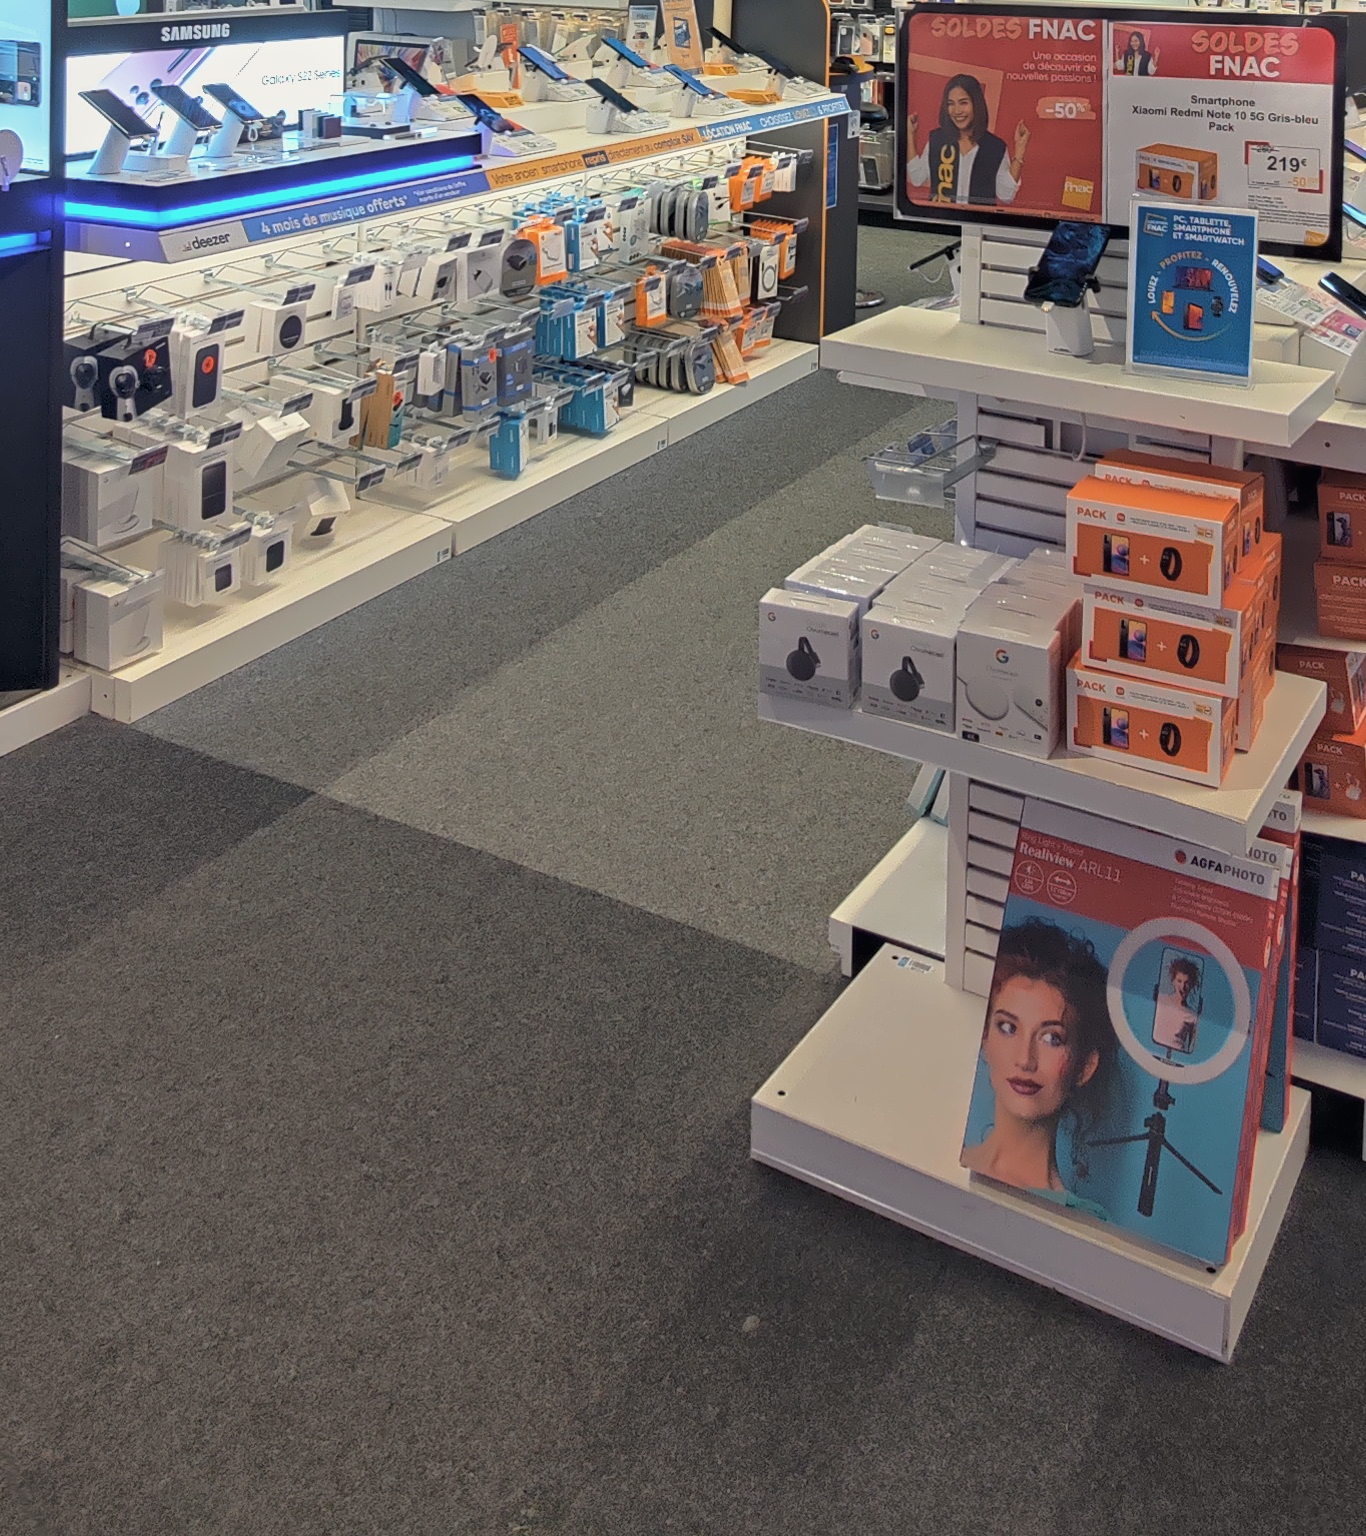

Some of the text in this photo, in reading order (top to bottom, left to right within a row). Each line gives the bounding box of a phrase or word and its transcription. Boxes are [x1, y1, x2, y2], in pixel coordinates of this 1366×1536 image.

[161, 23, 230, 42] SAMSUNG
[931, 17, 1096, 41] SOLDES FNAC
[1191, 30, 1299, 56] SOLDES
[1033, 51, 1097, 62] Une occasion
[1023, 61, 1096, 73] de découvrir de
[1209, 55, 1281, 78] FNAC
[261, 74, 295, 85] Galaxy
[1006, 72, 1091, 83] nouvelles passions
[1190, 95, 1255, 108] Smartphone
[1132, 105, 1319, 125] Xiaomi Redmi Note 10 5G Gris-bleu
[735, 122, 752, 134] FNAC
[1208, 122, 1235, 132] Pack
[491, 171, 513, 185] Votre
[514, 168, 537, 182] ancien
[541, 158, 583, 175] smartphone
[608, 145, 645, 161] directement
[654, 137, 681, 151] comptoir
[682, 133, 694, 144] SAV
[1267, 156, 1307, 172] 219€
[1064, 181, 1094, 194] fnac
[192, 232, 230, 250] deezer
[261, 222, 271, 235] 4
[273, 218, 300, 233] mois
[302, 212, 317, 226] de
[318, 205, 366, 223] musique
[1147, 224, 1168, 233] FNAC
[1173, 224, 1231, 235] SMARTPHONE
[1173, 232, 1245, 246] ET SMARTWATCH
[1147, 250, 1239, 313] LOUEZ PROFITEZ RENOUVELEZ
[1338, 492, 1366, 502] PACK
[1077, 506, 1106, 520] PACK
[1094, 591, 1125, 605] PACK
[806, 625, 839, 637] Chromecast
[910, 645, 944, 658] Chromecast
[1299, 660, 1325, 671] PACK
[1077, 679, 1106, 694] PACK
[1316, 743, 1343, 756] PACK
[1078, 858, 1122, 883] ARL11
[1190, 855, 1265, 886] AGFAPHOTO
